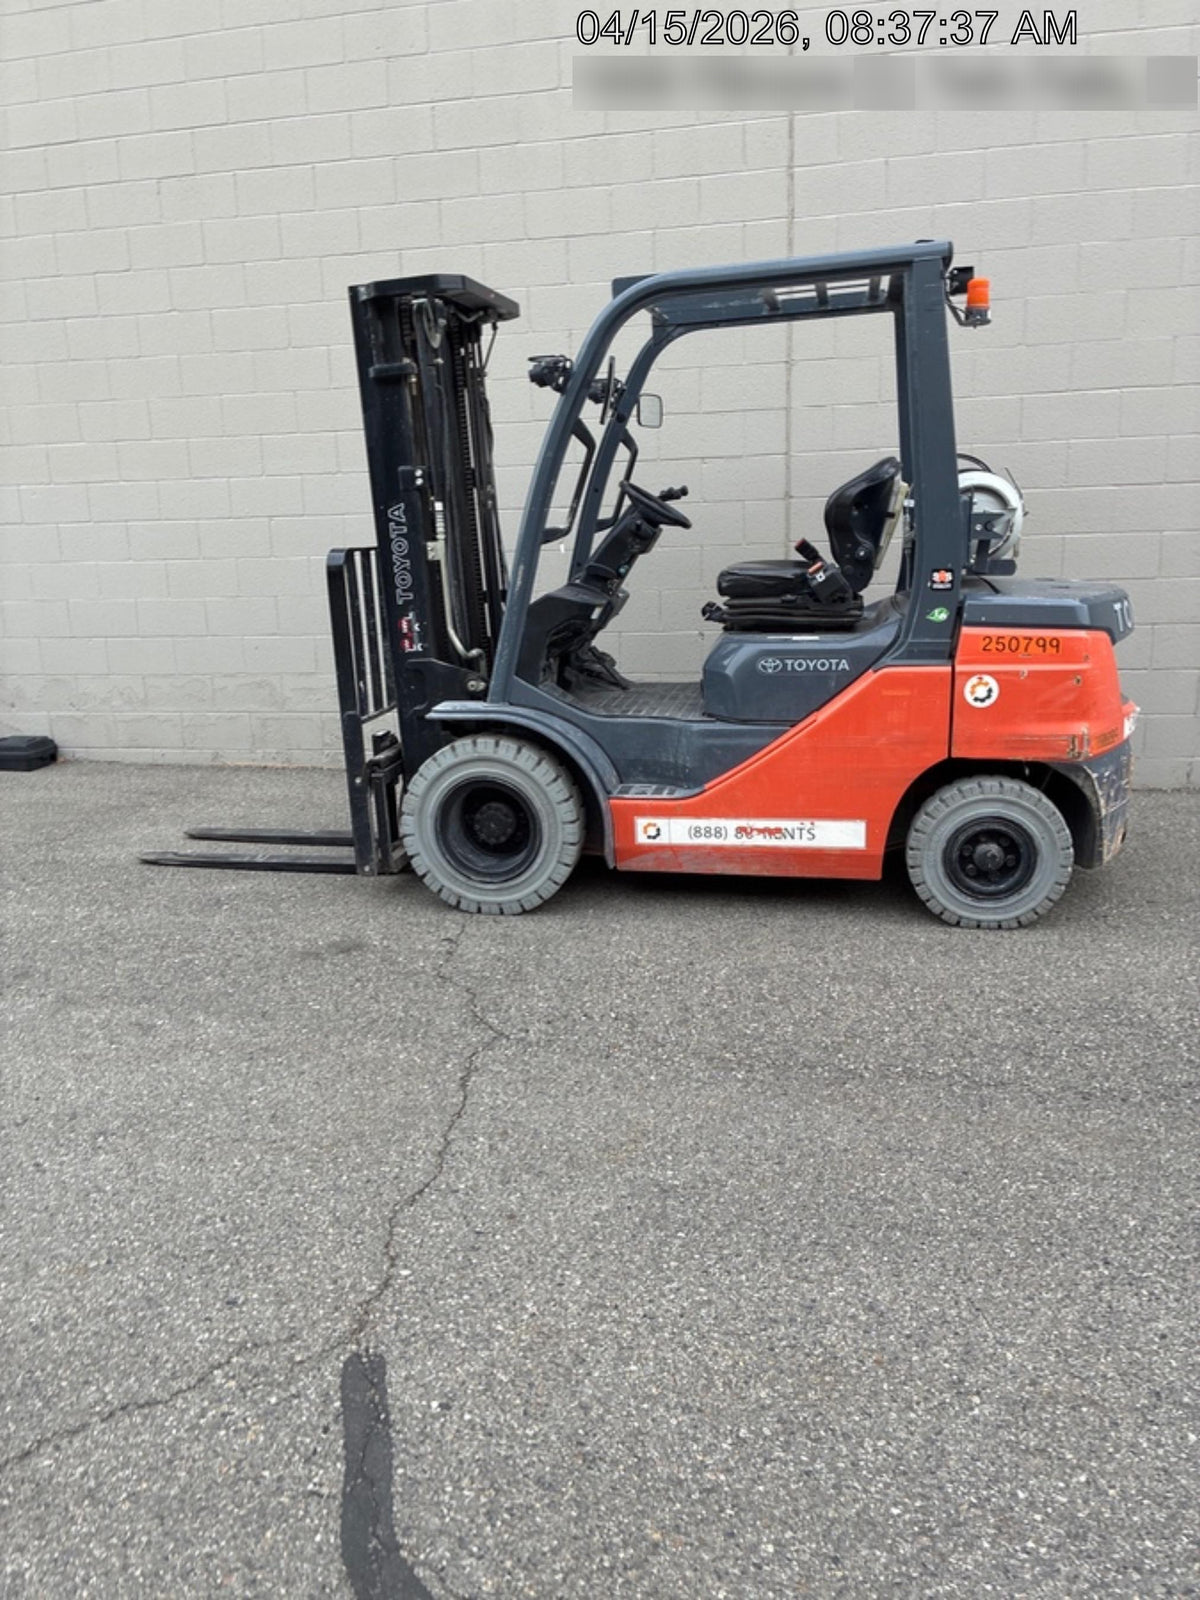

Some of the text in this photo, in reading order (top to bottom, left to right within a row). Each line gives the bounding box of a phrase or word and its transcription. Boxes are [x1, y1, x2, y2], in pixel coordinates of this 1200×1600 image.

[387, 502, 413, 605] TOYOTA
[981, 636, 1061, 653] 250799
[784, 658, 850, 671] TOYOTA
[687, 825, 728, 840] (888)
